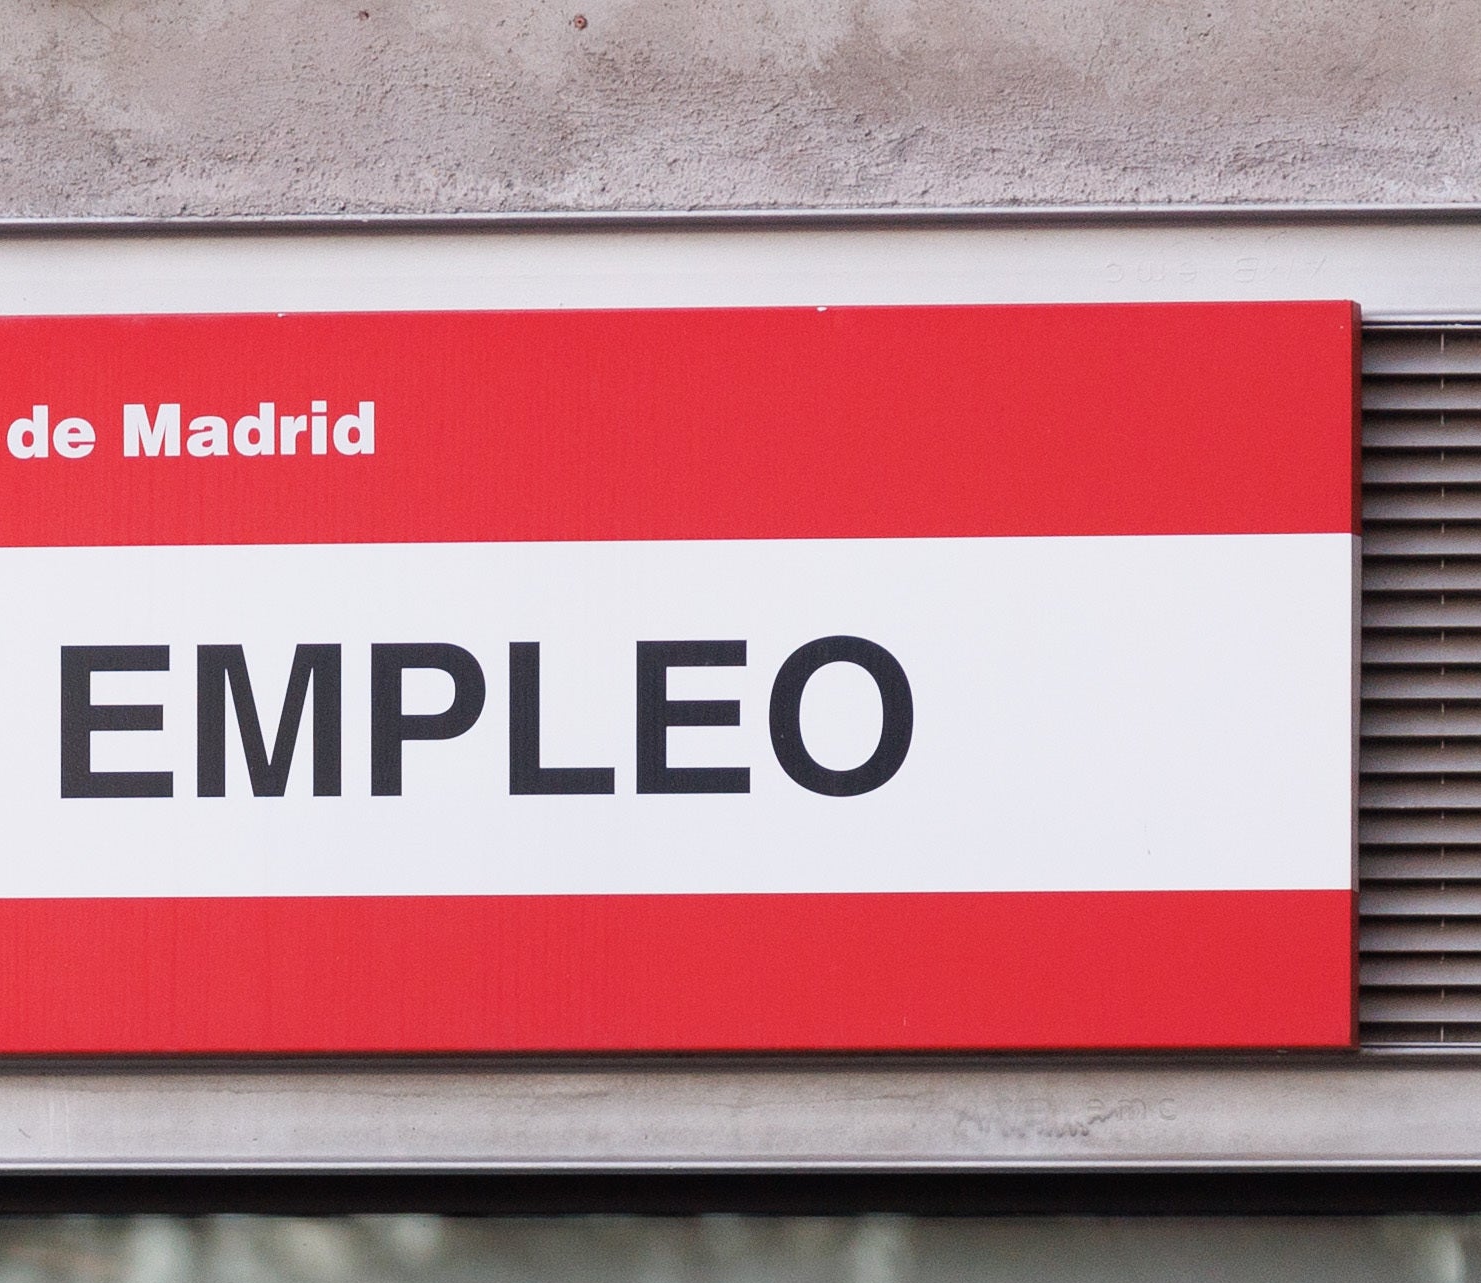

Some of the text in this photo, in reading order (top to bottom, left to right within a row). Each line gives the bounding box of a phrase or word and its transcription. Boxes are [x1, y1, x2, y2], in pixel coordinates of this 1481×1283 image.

[5, 406, 96, 459] de
[122, 401, 377, 458] Madrid
[55, 632, 919, 799] EMPLEO
